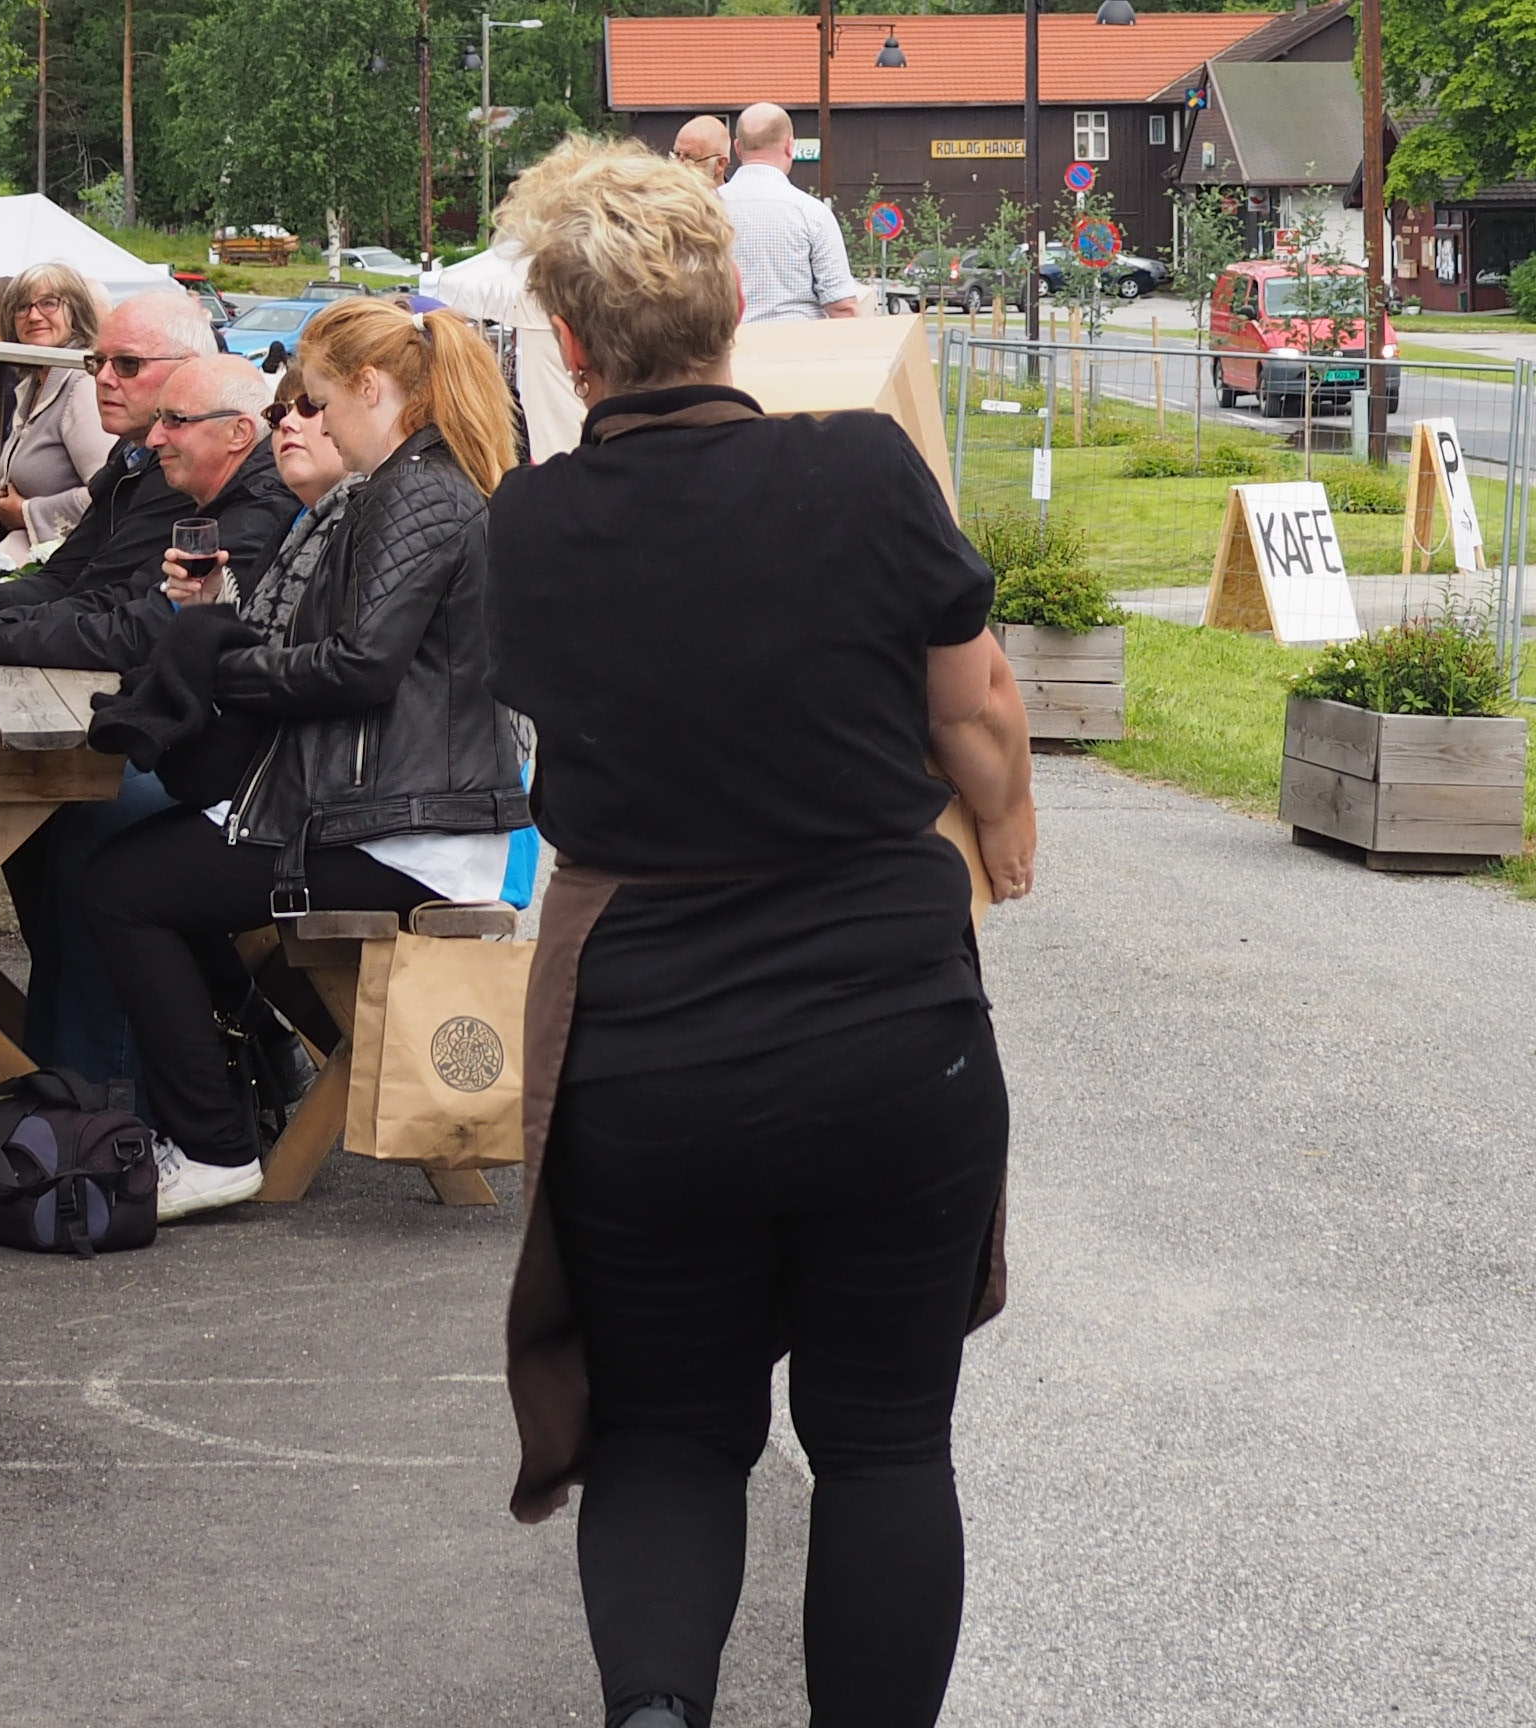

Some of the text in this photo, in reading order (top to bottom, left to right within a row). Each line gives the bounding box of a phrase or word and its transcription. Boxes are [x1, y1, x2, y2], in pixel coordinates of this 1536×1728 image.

[936, 141, 980, 155] ROLLAG
[1437, 431, 1458, 500] P
[1256, 510, 1342, 577] KAFE
